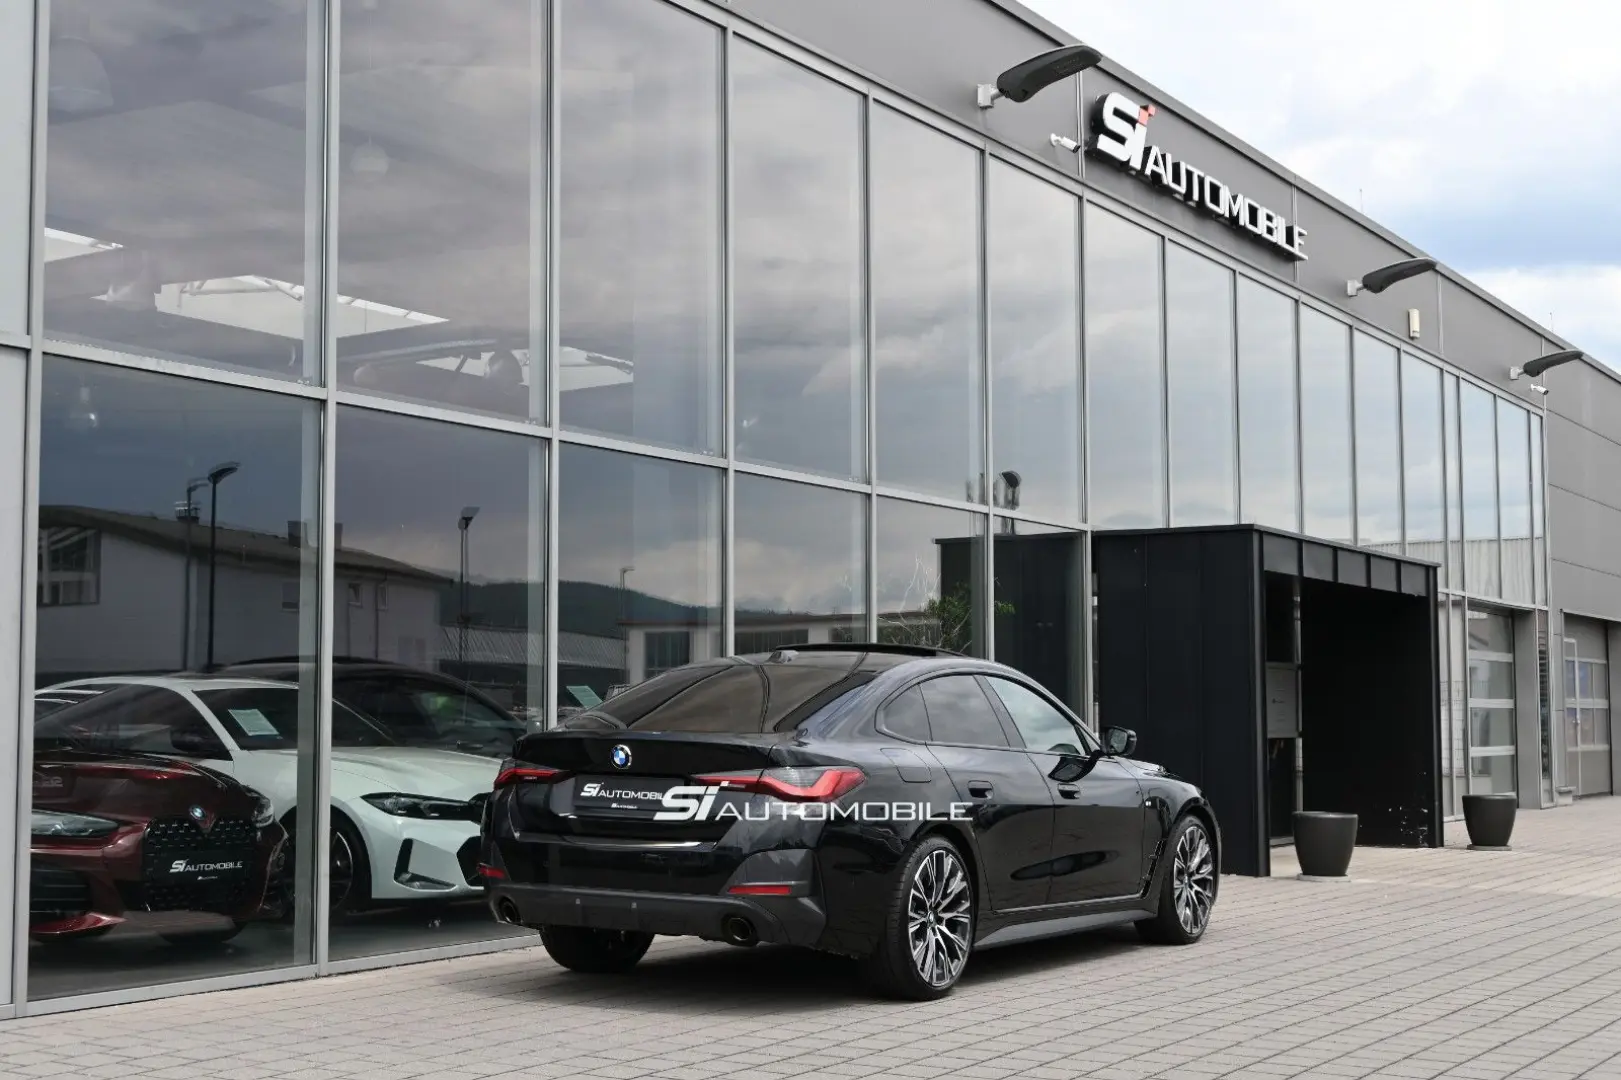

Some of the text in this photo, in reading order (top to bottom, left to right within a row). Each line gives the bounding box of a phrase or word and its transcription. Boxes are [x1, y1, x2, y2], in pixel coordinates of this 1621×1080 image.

[1144, 145, 1308, 260] AUTOMOBILE
[598, 789, 664, 800] AUTOMOBIL
[184, 861, 243, 871] AUTOMOBILE
